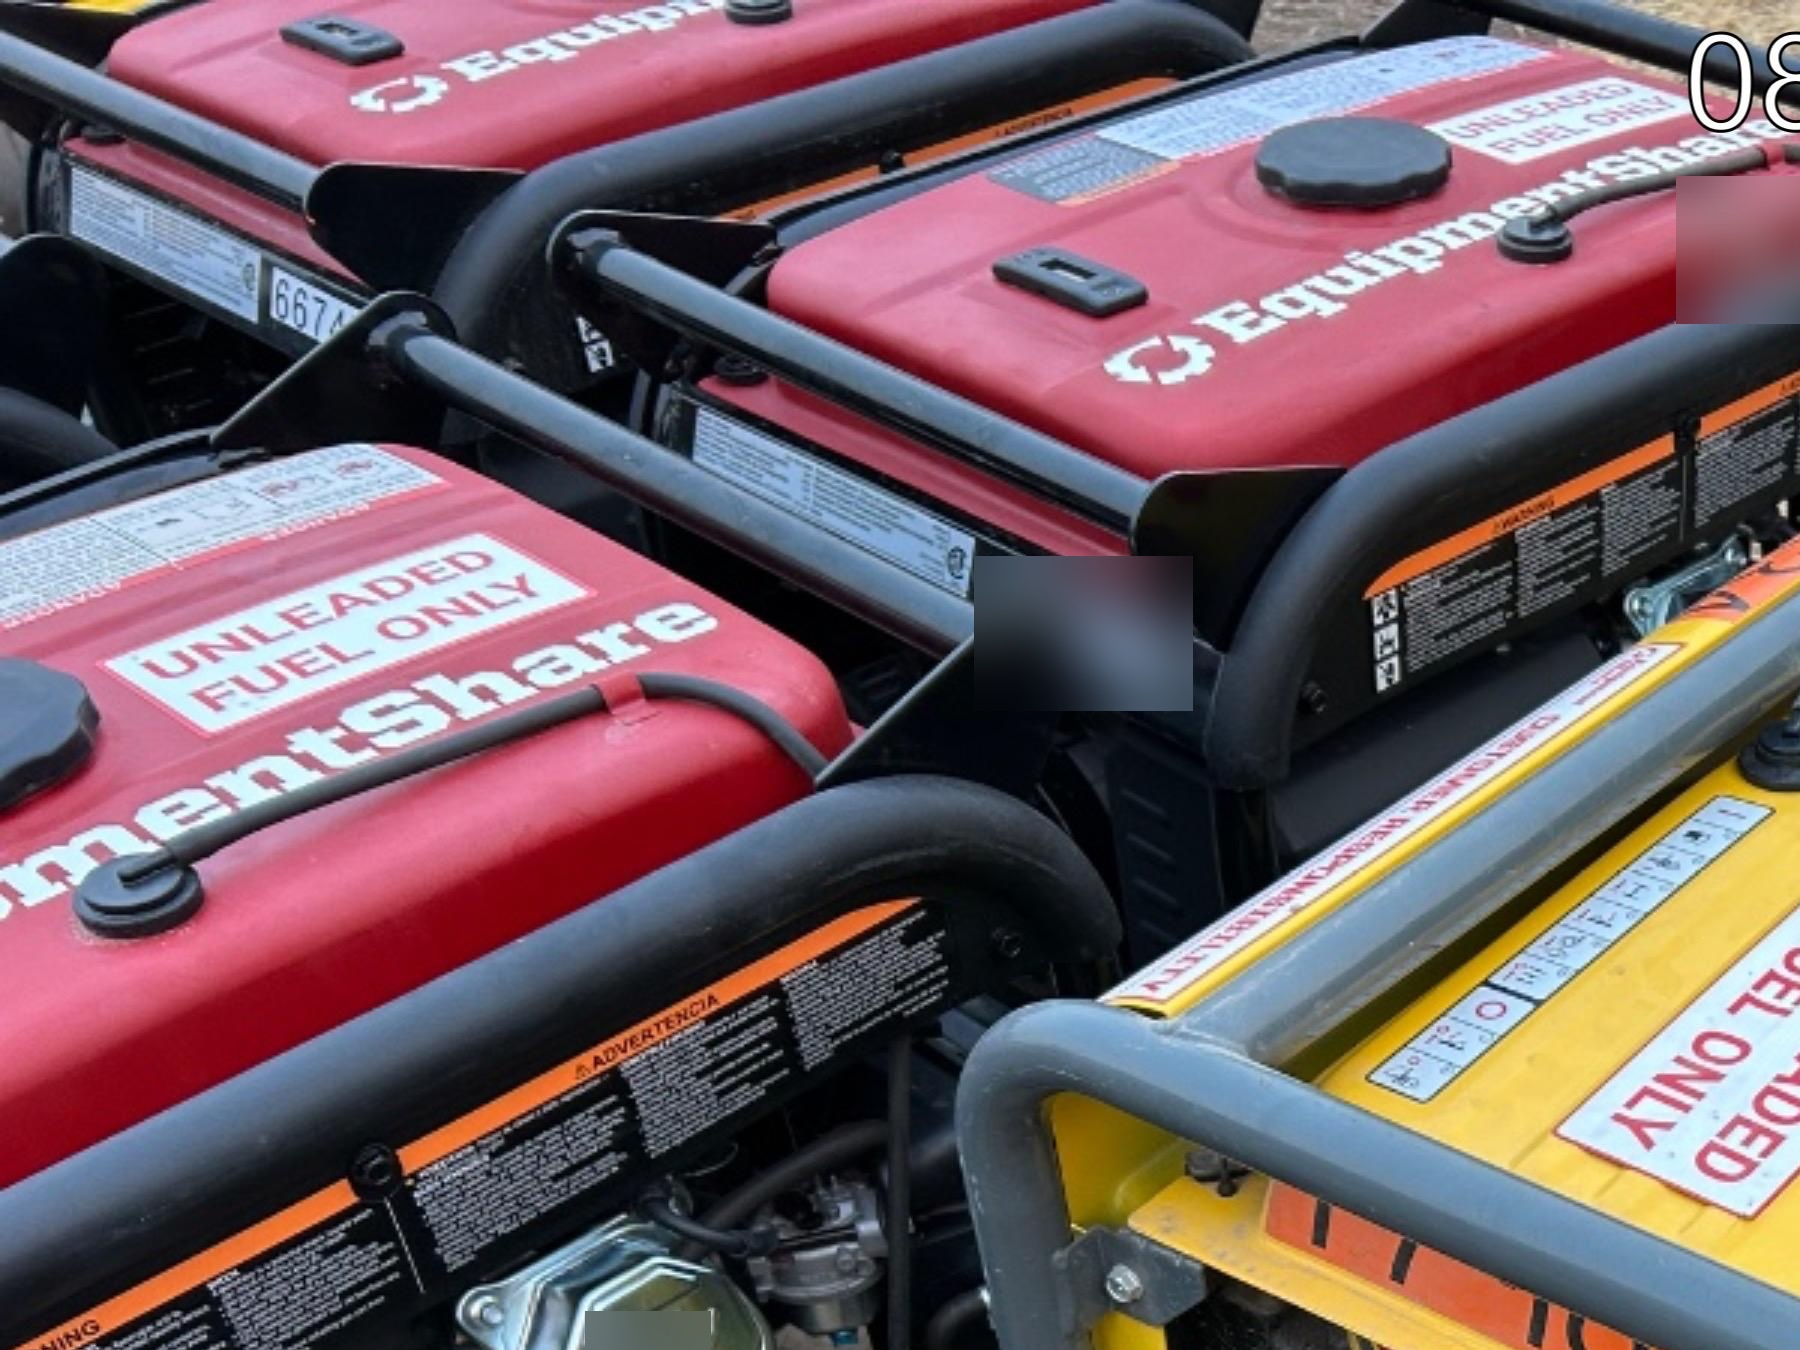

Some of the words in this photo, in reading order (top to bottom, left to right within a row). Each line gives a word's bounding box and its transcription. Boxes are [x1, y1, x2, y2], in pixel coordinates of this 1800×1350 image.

[1443, 84, 1635, 140] UNLEADED
[1489, 126, 1590, 156] FUEL
[1584, 94, 1676, 128] ONLY
[139, 545, 497, 683] UNLEADED
[189, 644, 377, 713] FUEL
[377, 572, 543, 645] ONLY
[0, 602, 718, 920] mentShare
[590, 992, 719, 1069] ADVERTENCIA
[1610, 1025, 1754, 1150] ONLY
